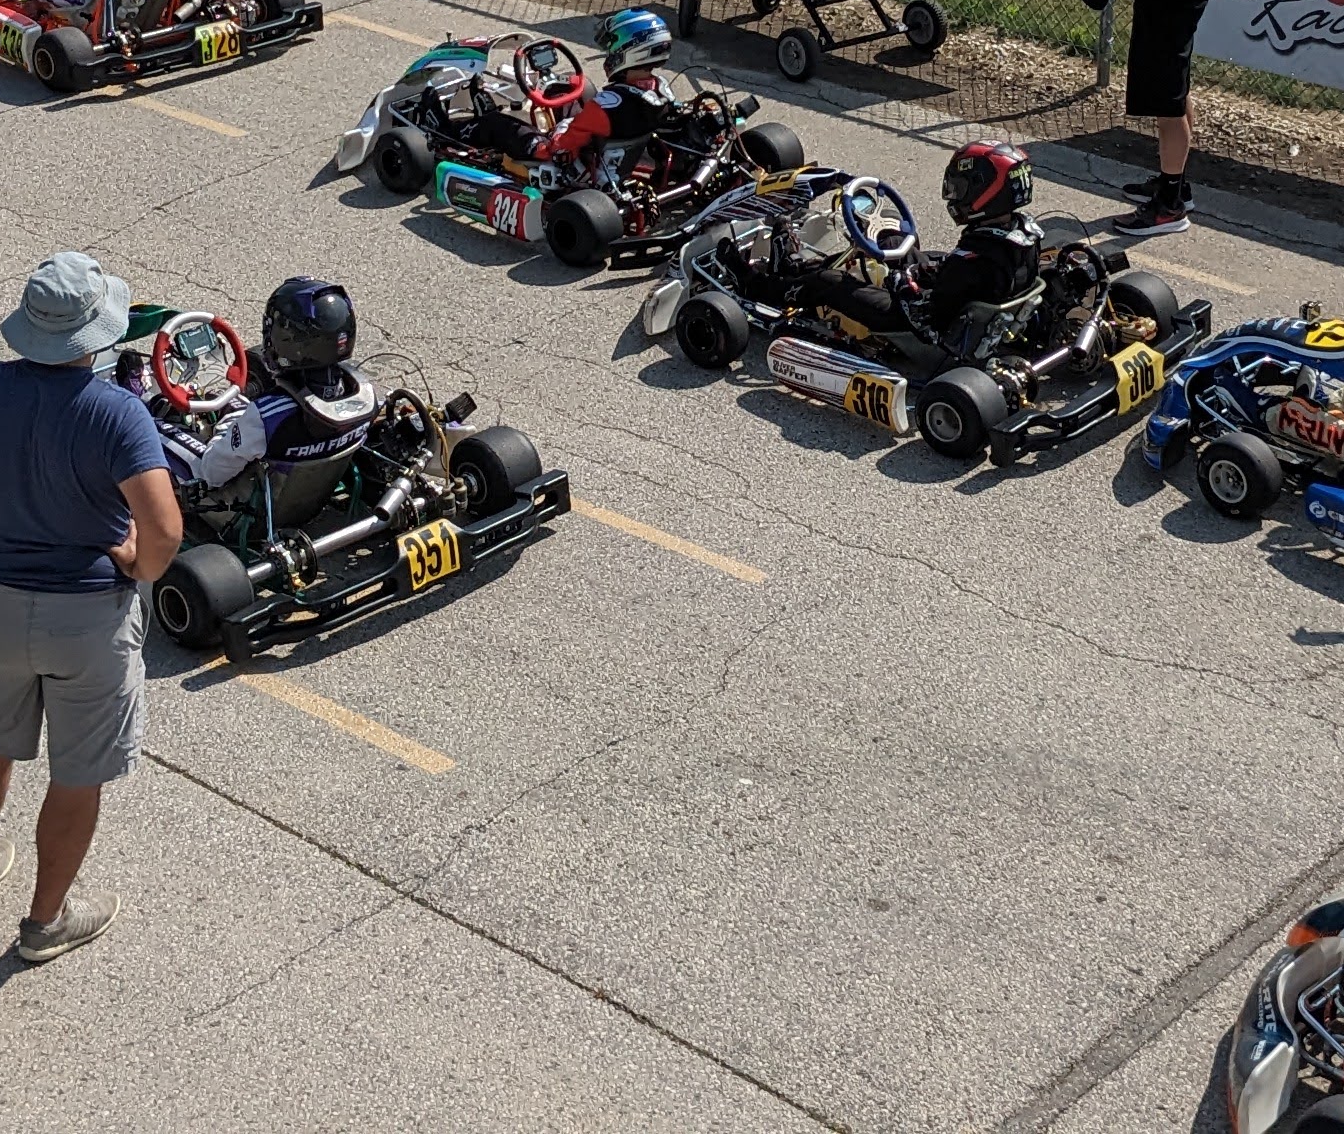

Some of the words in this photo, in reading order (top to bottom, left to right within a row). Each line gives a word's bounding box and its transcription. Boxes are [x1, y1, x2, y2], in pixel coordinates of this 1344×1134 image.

[492, 192, 520, 236] 324
[851, 376, 891, 427] 316
[1122, 350, 1156, 403] 316
[406, 521, 459, 585] 351
